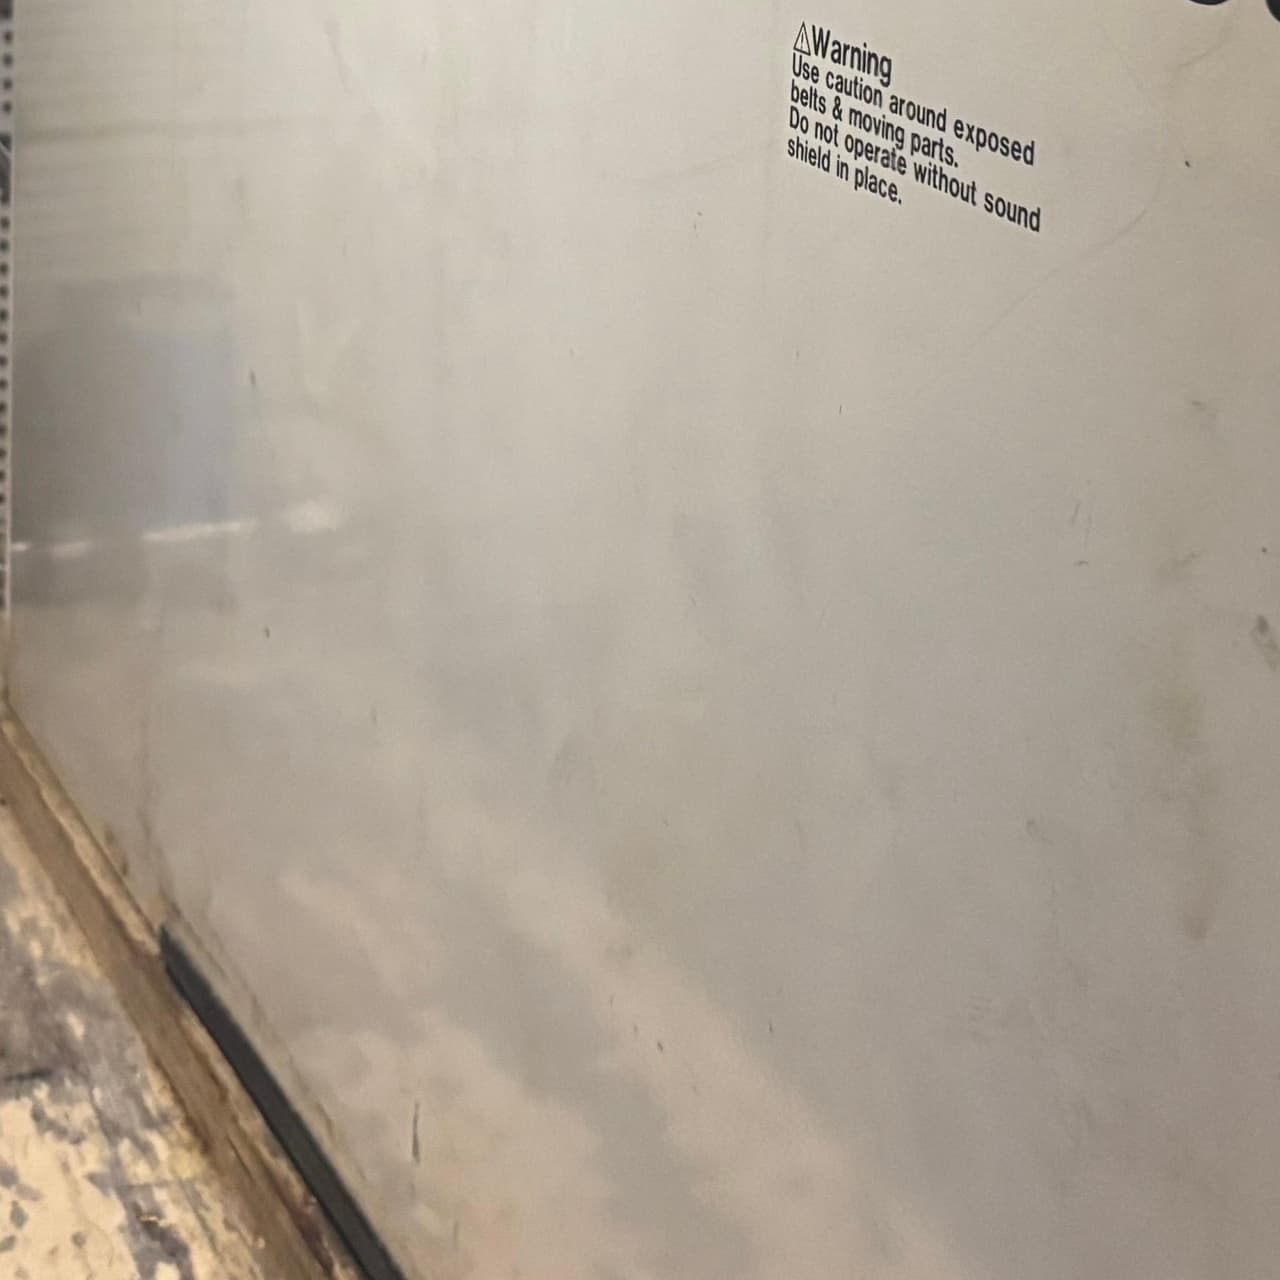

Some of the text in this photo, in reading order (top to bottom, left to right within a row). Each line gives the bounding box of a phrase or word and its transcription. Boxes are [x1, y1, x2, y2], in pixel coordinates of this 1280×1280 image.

[812, 24, 892, 87] Warning
[790, 78, 959, 168] belts & moving parts.
[792, 52, 1035, 166] Use caution around exposed
[787, 136, 903, 206] shield in place.
[789, 105, 1042, 233] Do not operate without sound
